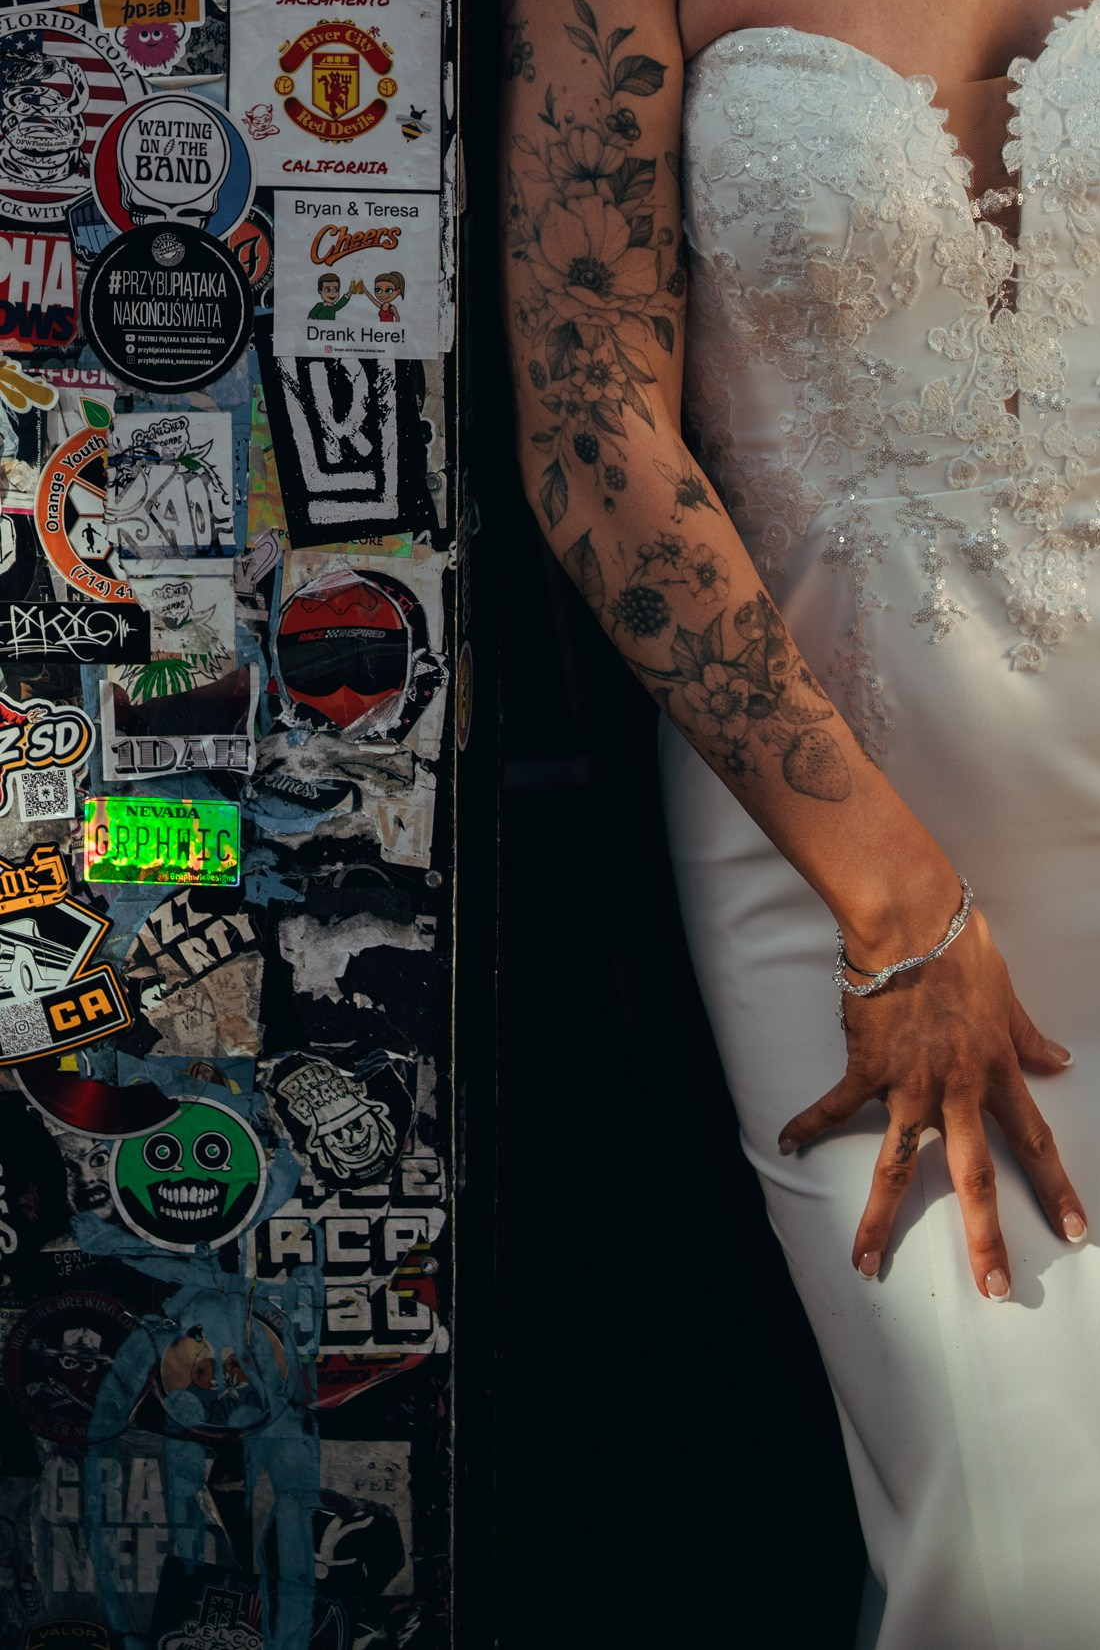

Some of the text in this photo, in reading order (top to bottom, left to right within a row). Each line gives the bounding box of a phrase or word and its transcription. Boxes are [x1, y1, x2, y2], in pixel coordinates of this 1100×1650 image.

[0, 12, 135, 82] LORIDA.COM
[297, 29, 375, 53] River City
[137, 119, 213, 140] WAITING
[296, 108, 375, 136] Red Devils
[15, 138, 68, 147] DFWFlorida.com
[140, 138, 208, 157] ON THE
[135, 154, 213, 185] BAND
[282, 159, 389, 175] CALIFORNIA
[294, 200, 419, 218] Bryan & Teresa
[310, 224, 402, 267] Cheers
[307, 326, 406, 344] Drank Here!
[46, 434, 108, 534] Orange Youth
[70, 564, 113, 597] (714)
[297, 628, 387, 643] RACE INSPIRED
[126, 804, 201, 819] NEVADA
[94, 824, 232, 862] GRPHWIC
[49, 987, 115, 1032] CA
[56, 1296, 118, 1318] BREWING
[38, 1627, 98, 1640] VALOR
